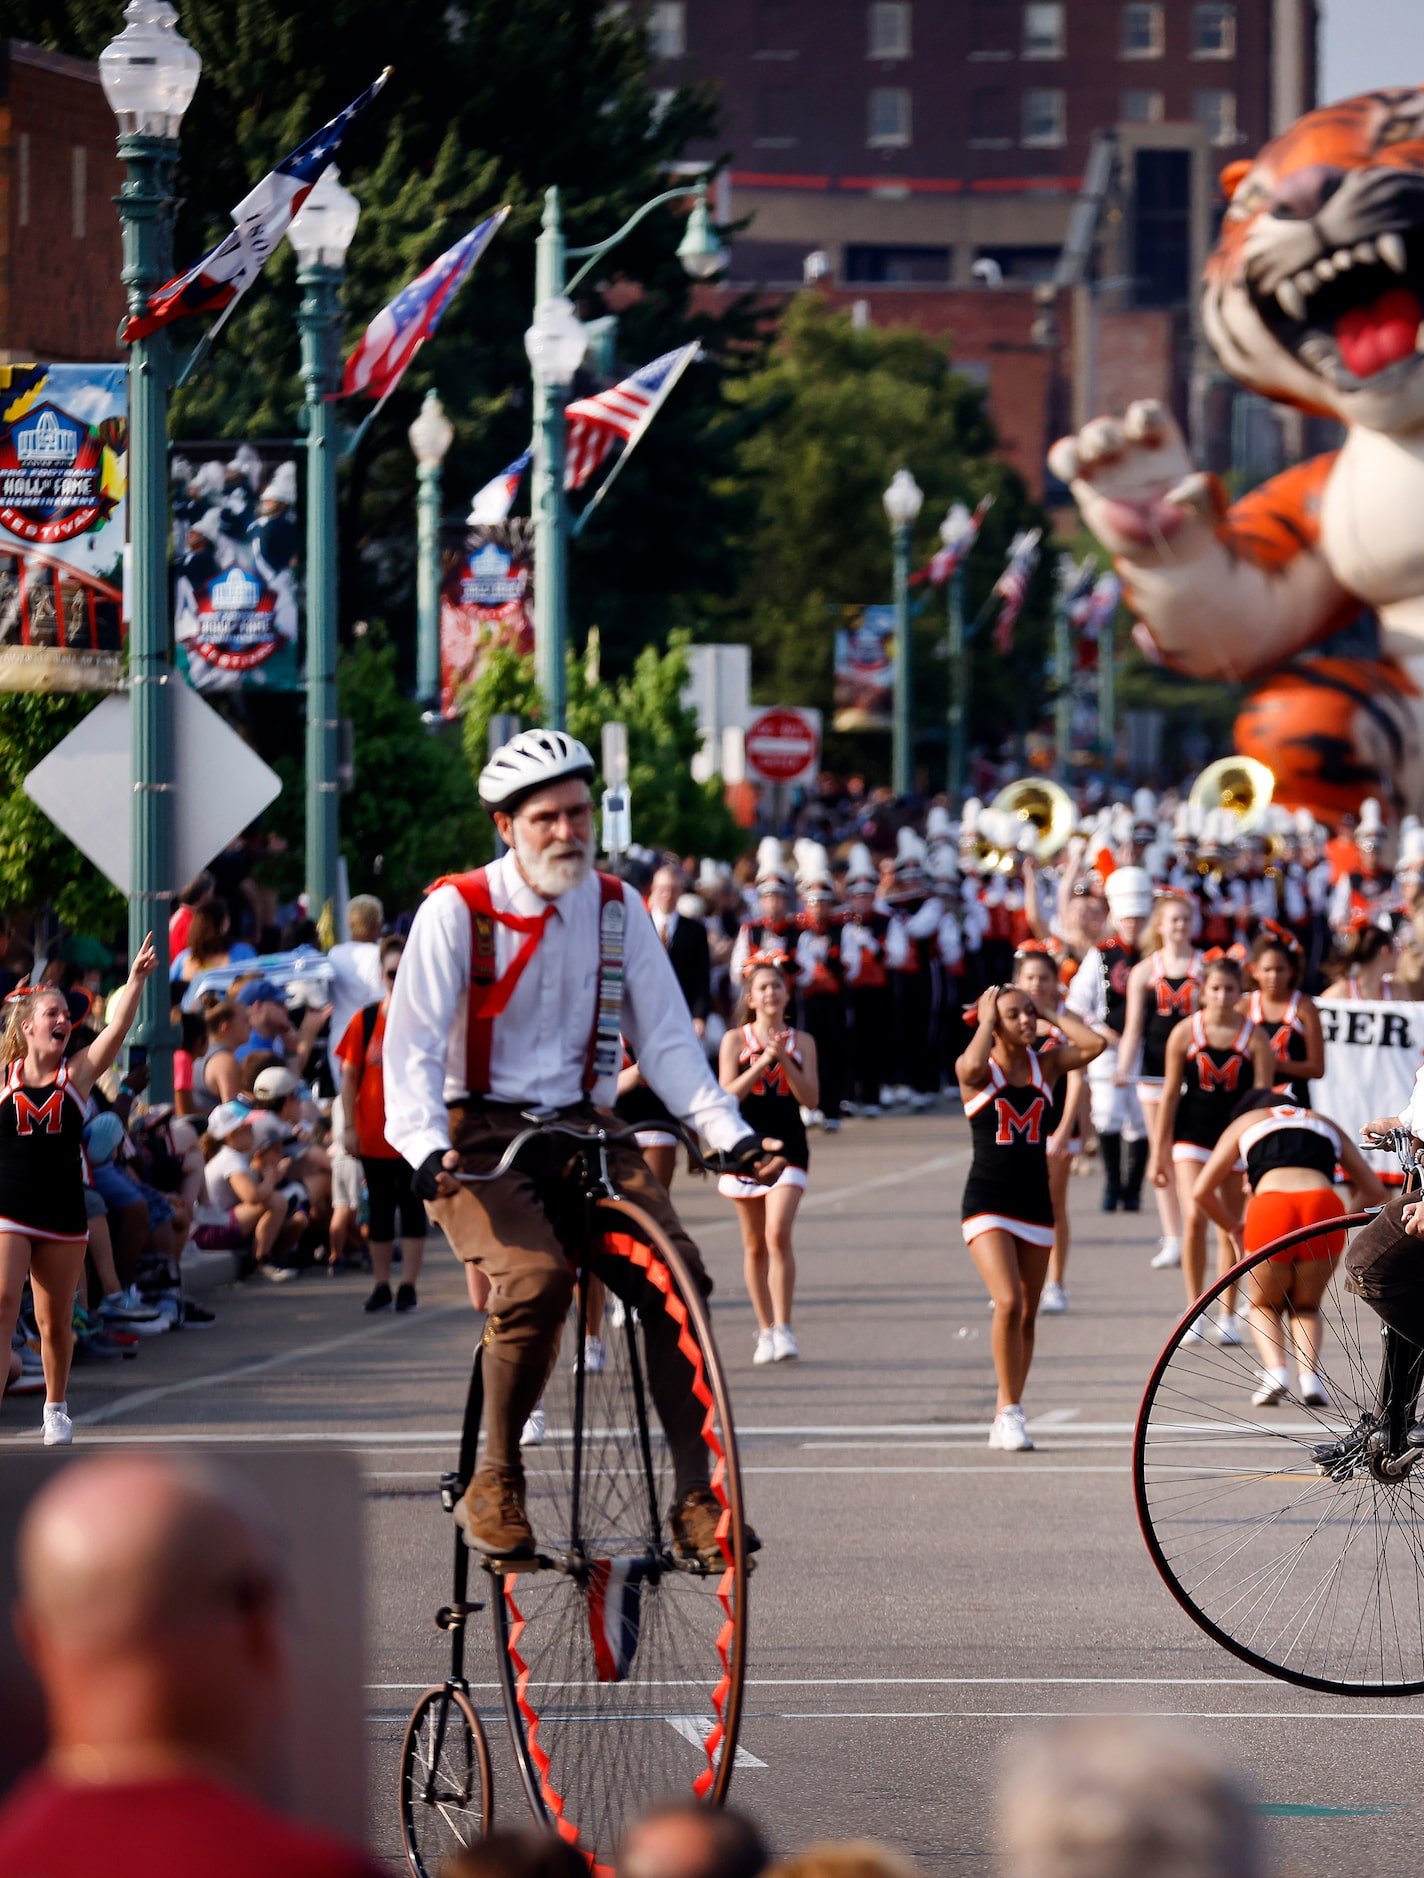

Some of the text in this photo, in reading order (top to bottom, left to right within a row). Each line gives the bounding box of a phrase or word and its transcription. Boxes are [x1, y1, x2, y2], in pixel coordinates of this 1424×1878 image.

[3, 477, 43, 496] HALL
[53, 477, 93, 496] FAME
[1, 508, 96, 538] FESTIVAL
[1156, 978, 1195, 1016] M
[1319, 1008, 1412, 1048] GER
[1197, 1052, 1243, 1092] M
[13, 1090, 64, 1137] M
[994, 1096, 1044, 1145] M
